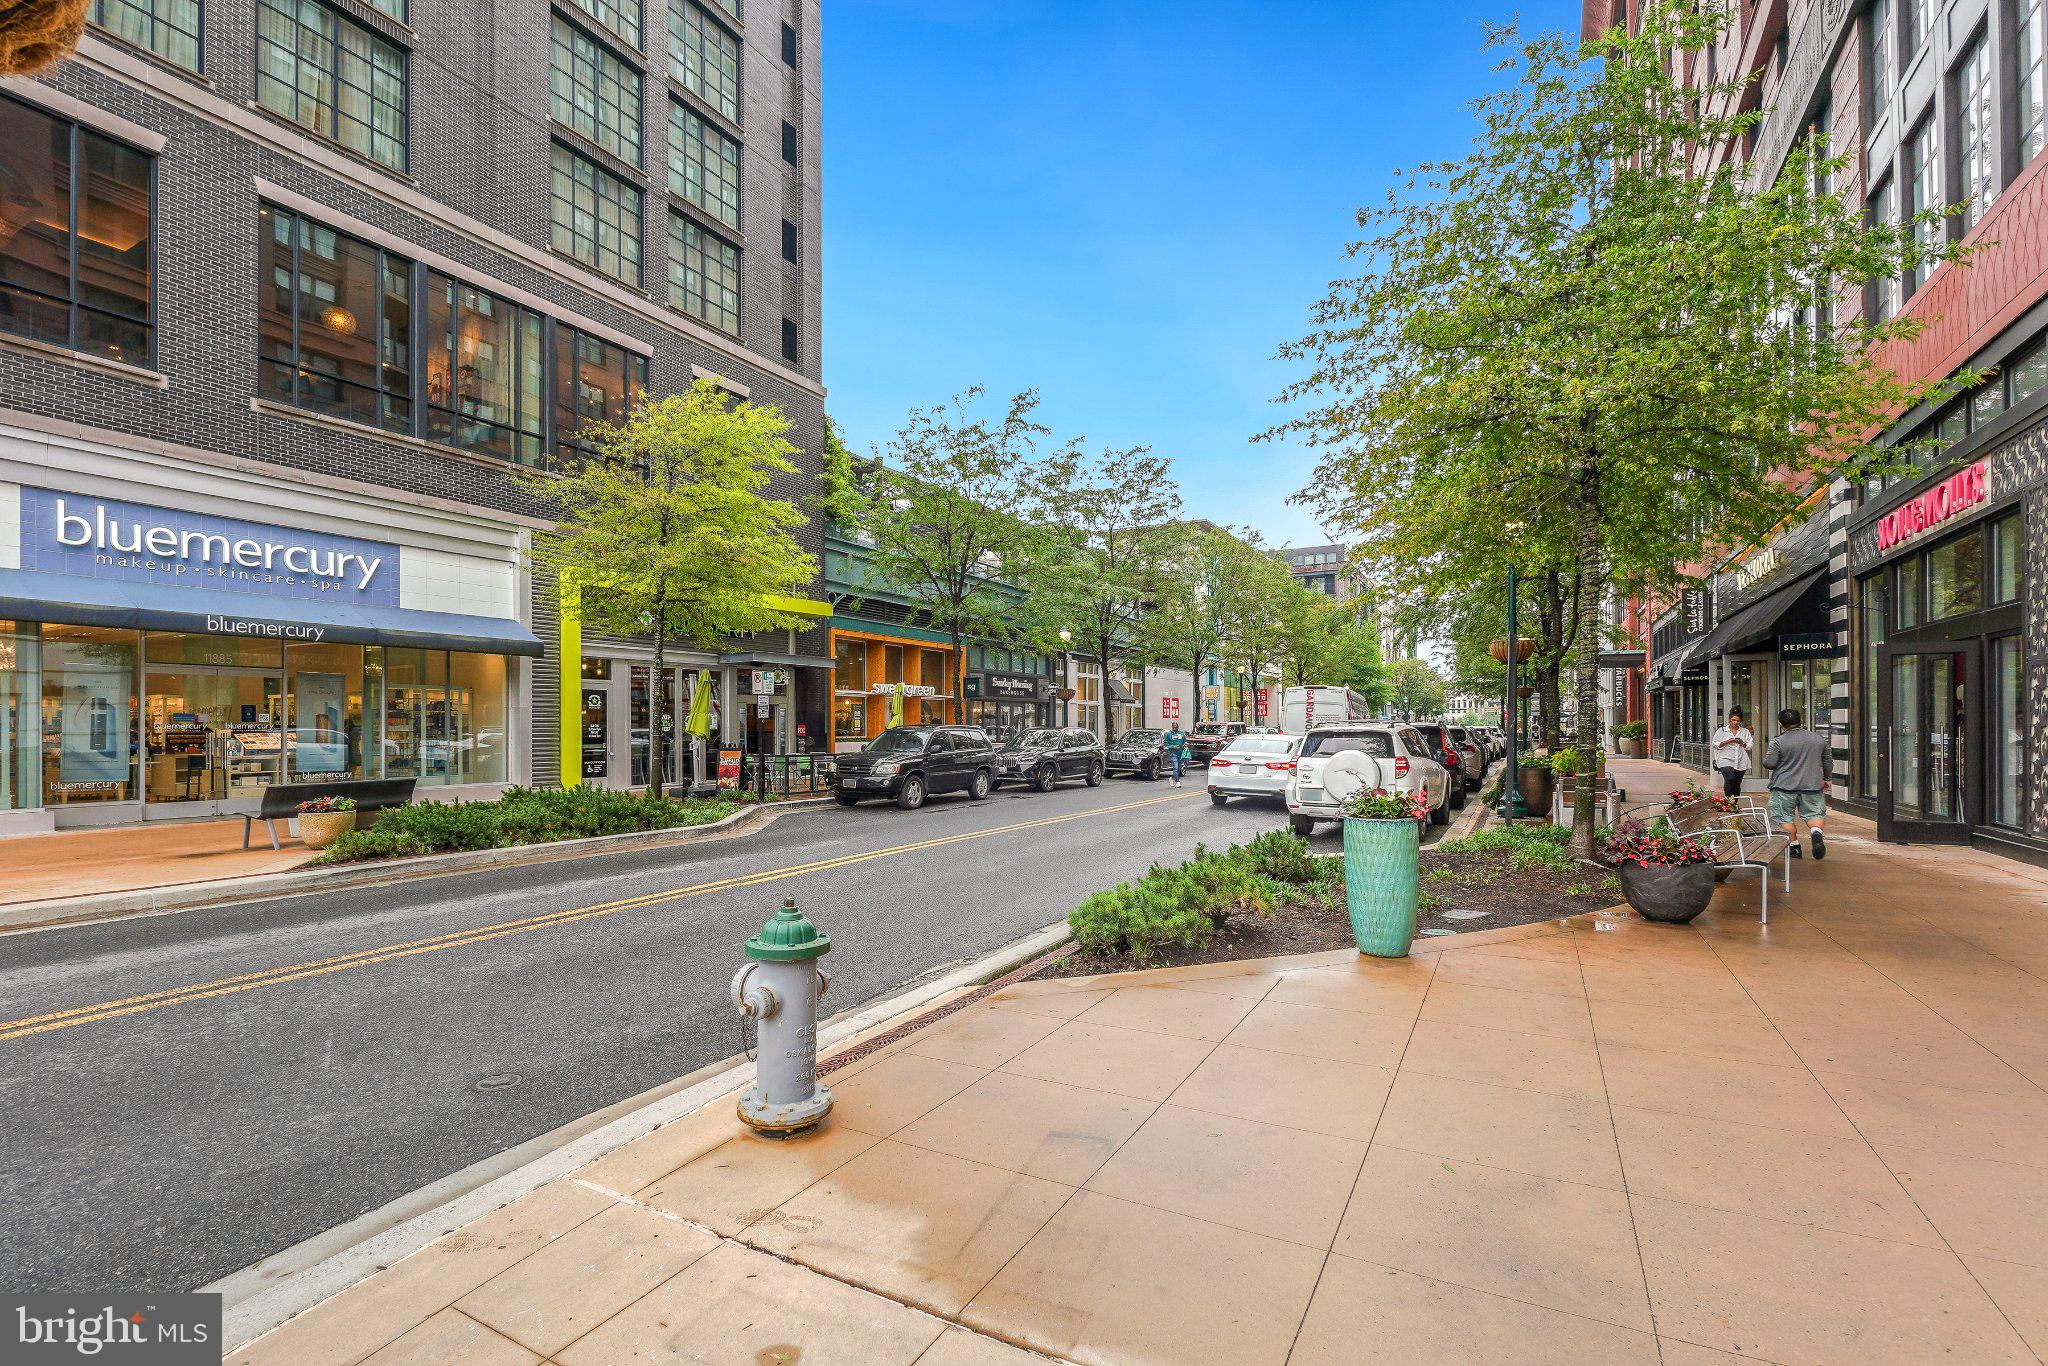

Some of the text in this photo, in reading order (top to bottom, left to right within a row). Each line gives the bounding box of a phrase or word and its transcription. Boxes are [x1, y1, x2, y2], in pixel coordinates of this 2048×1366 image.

[56, 499, 381, 590] bluemercury
[95, 552, 341, 592] makeup skincare spa
[1687, 609, 1698, 618] la
[207, 615, 324, 642] bluemercury
[1783, 642, 1833, 651] SEPHORA
[204, 653, 233, 664] 11885
[967, 684, 976, 692] sg
[992, 677, 1011, 691] Sunday
[872, 683, 935, 697] swetgreen
[1305, 690, 1314, 734] GARDAWO
[154, 723, 207, 731] bluemercury
[225, 722, 274, 731] bluemercury
[302, 771, 352, 780] bluemercury
[50, 781, 121, 790] bluemercury
[796, 1024, 816, 1038] CLO
